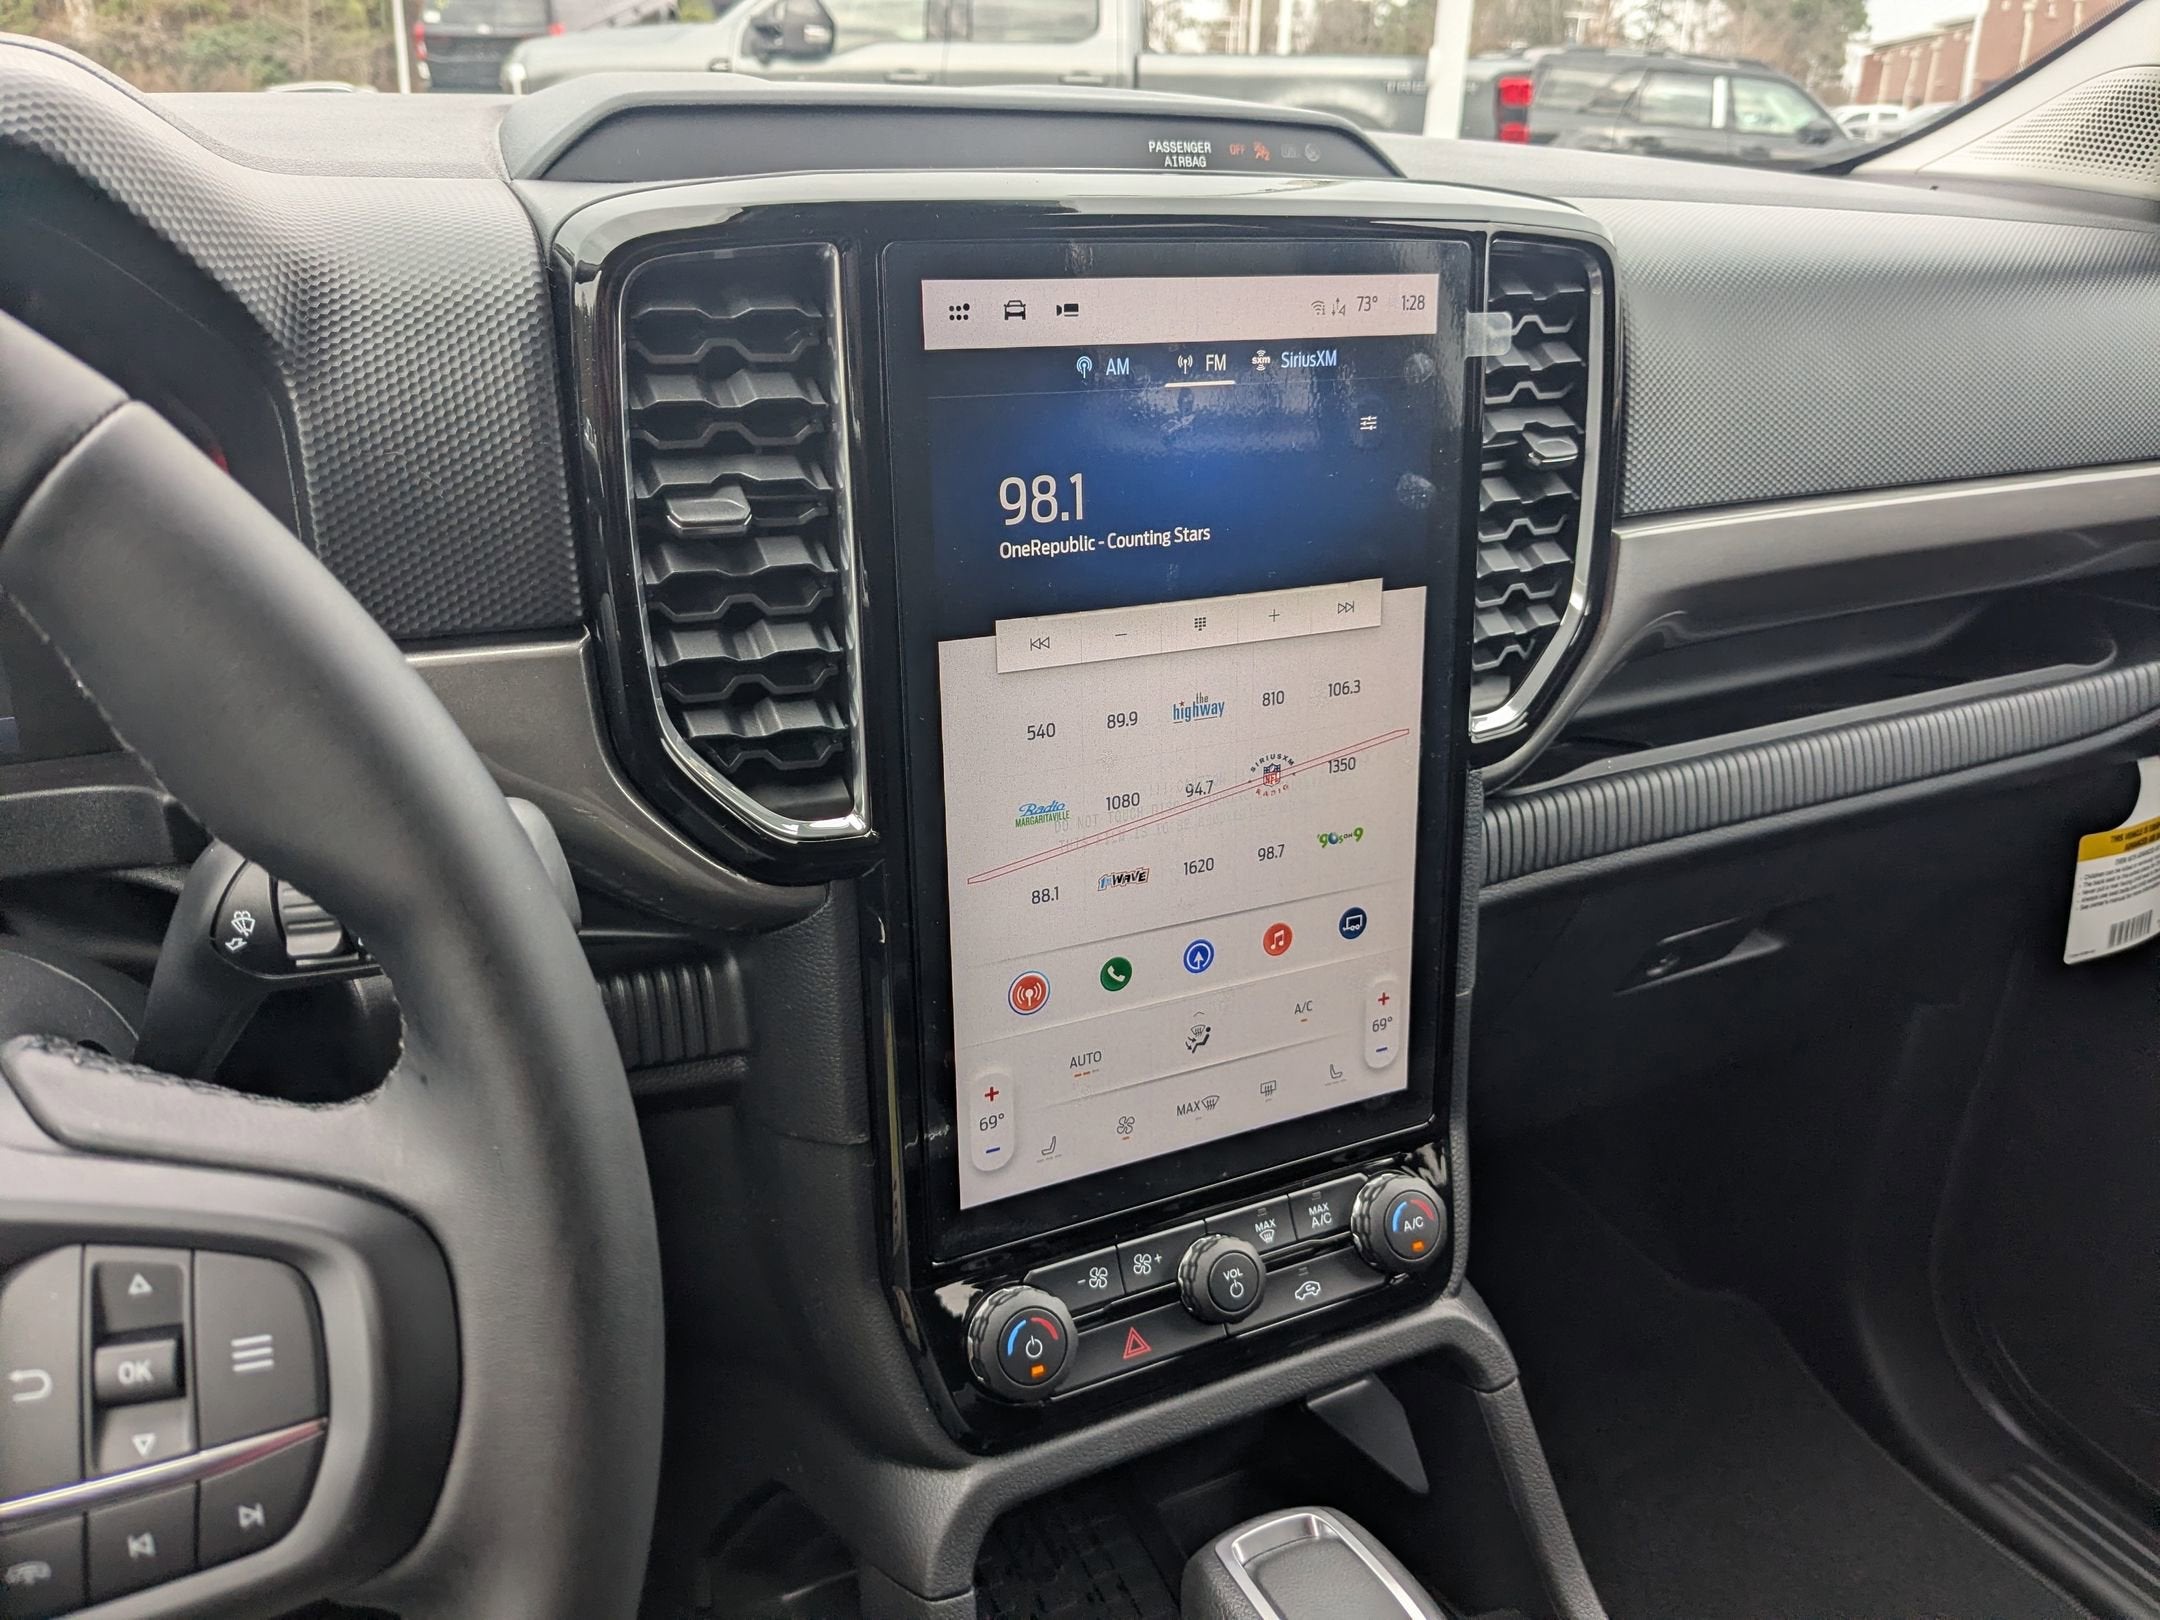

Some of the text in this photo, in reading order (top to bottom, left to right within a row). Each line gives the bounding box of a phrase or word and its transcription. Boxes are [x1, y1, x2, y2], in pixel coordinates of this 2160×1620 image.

[1148, 141, 1212, 156] PASSENGER
[1229, 144, 1245, 156] OFF
[1164, 155, 1207, 168] AIRBAG
[1357, 295, 1425, 312] 73° 1:28
[1106, 358, 1130, 376] AM
[1205, 354, 1227, 371] FM
[1280, 349, 1337, 369] SiriusXM
[1000, 473, 1084, 526] 98.1
[1000, 536, 1095, 559] OneRepublic
[1107, 530, 1171, 551] Counting
[1174, 525, 1211, 544] Stars
[1328, 680, 1362, 698] 106.3
[1196, 692, 1208, 704] the
[1262, 690, 1285, 707] 810
[1107, 711, 1138, 729] 89.9
[1173, 701, 1225, 722] highway
[1027, 722, 1056, 741] 540
[1251, 753, 1296, 773] SIRIUSXM
[1328, 757, 1356, 774] 1350
[1185, 780, 1214, 797] 94.7
[1256, 784, 1290, 797] RADIO
[1019, 800, 1067, 816] Radio
[1106, 792, 1140, 811] 1080
[1015, 810, 1070, 828] MARGARITAVILLE
[1353, 827, 1364, 842] 9
[1258, 844, 1286, 861] 98.7
[1183, 857, 1215, 876] 1620
[1112, 870, 1147, 886] WAVE
[1031, 887, 1060, 905] 88.1
[1294, 1000, 1313, 1015] A/C
[1372, 1016, 1393, 1033] 69°
[1070, 1051, 1102, 1068] AUTO
[1176, 1100, 1201, 1116] MAX
[979, 1113, 1005, 1131] 69°
[1308, 1203, 1330, 1216] MAX
[1255, 1218, 1277, 1233] MAX
[1311, 1211, 1332, 1229] A/C
[1403, 1216, 1424, 1231] A/C
[1223, 1266, 1244, 1281] VOL
[118, 1360, 154, 1385] OK
